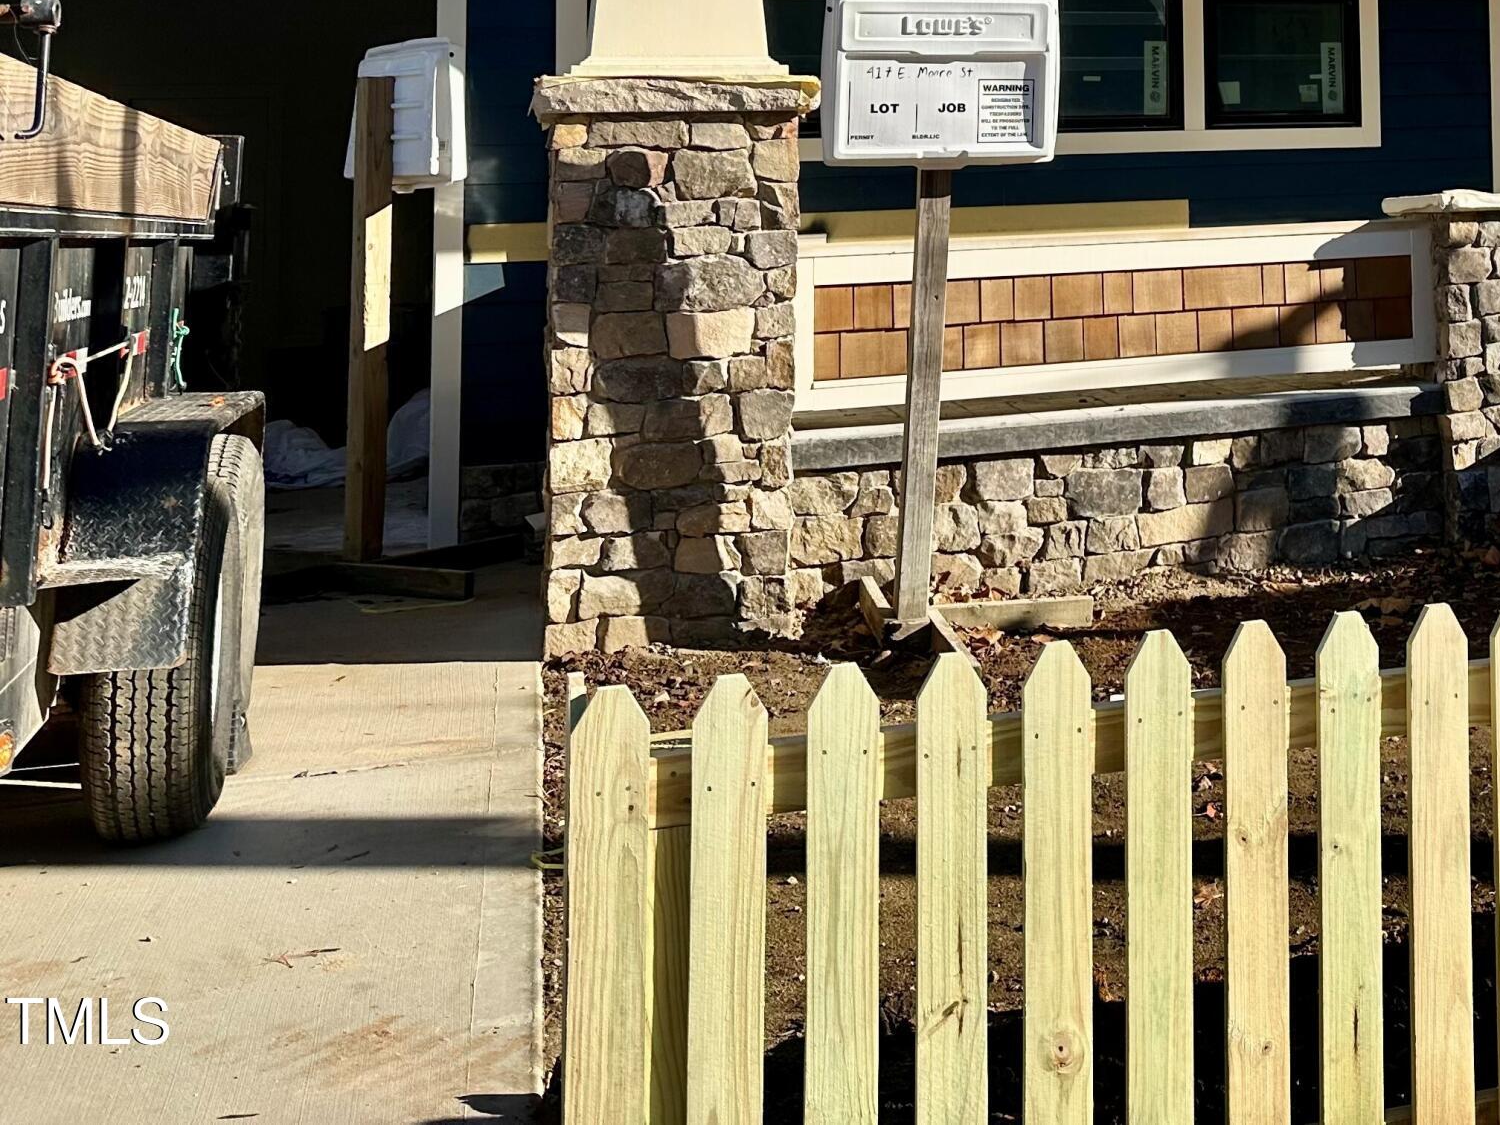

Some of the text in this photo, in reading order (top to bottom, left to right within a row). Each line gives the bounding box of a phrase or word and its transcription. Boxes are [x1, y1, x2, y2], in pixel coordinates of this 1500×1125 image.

[1151, 45, 1161, 89] MARVIN
[1327, 46, 1337, 88] MARVIN
[982, 84, 1030, 92] WARNING
[870, 103, 900, 114] LOT
[938, 103, 967, 113] JOB
